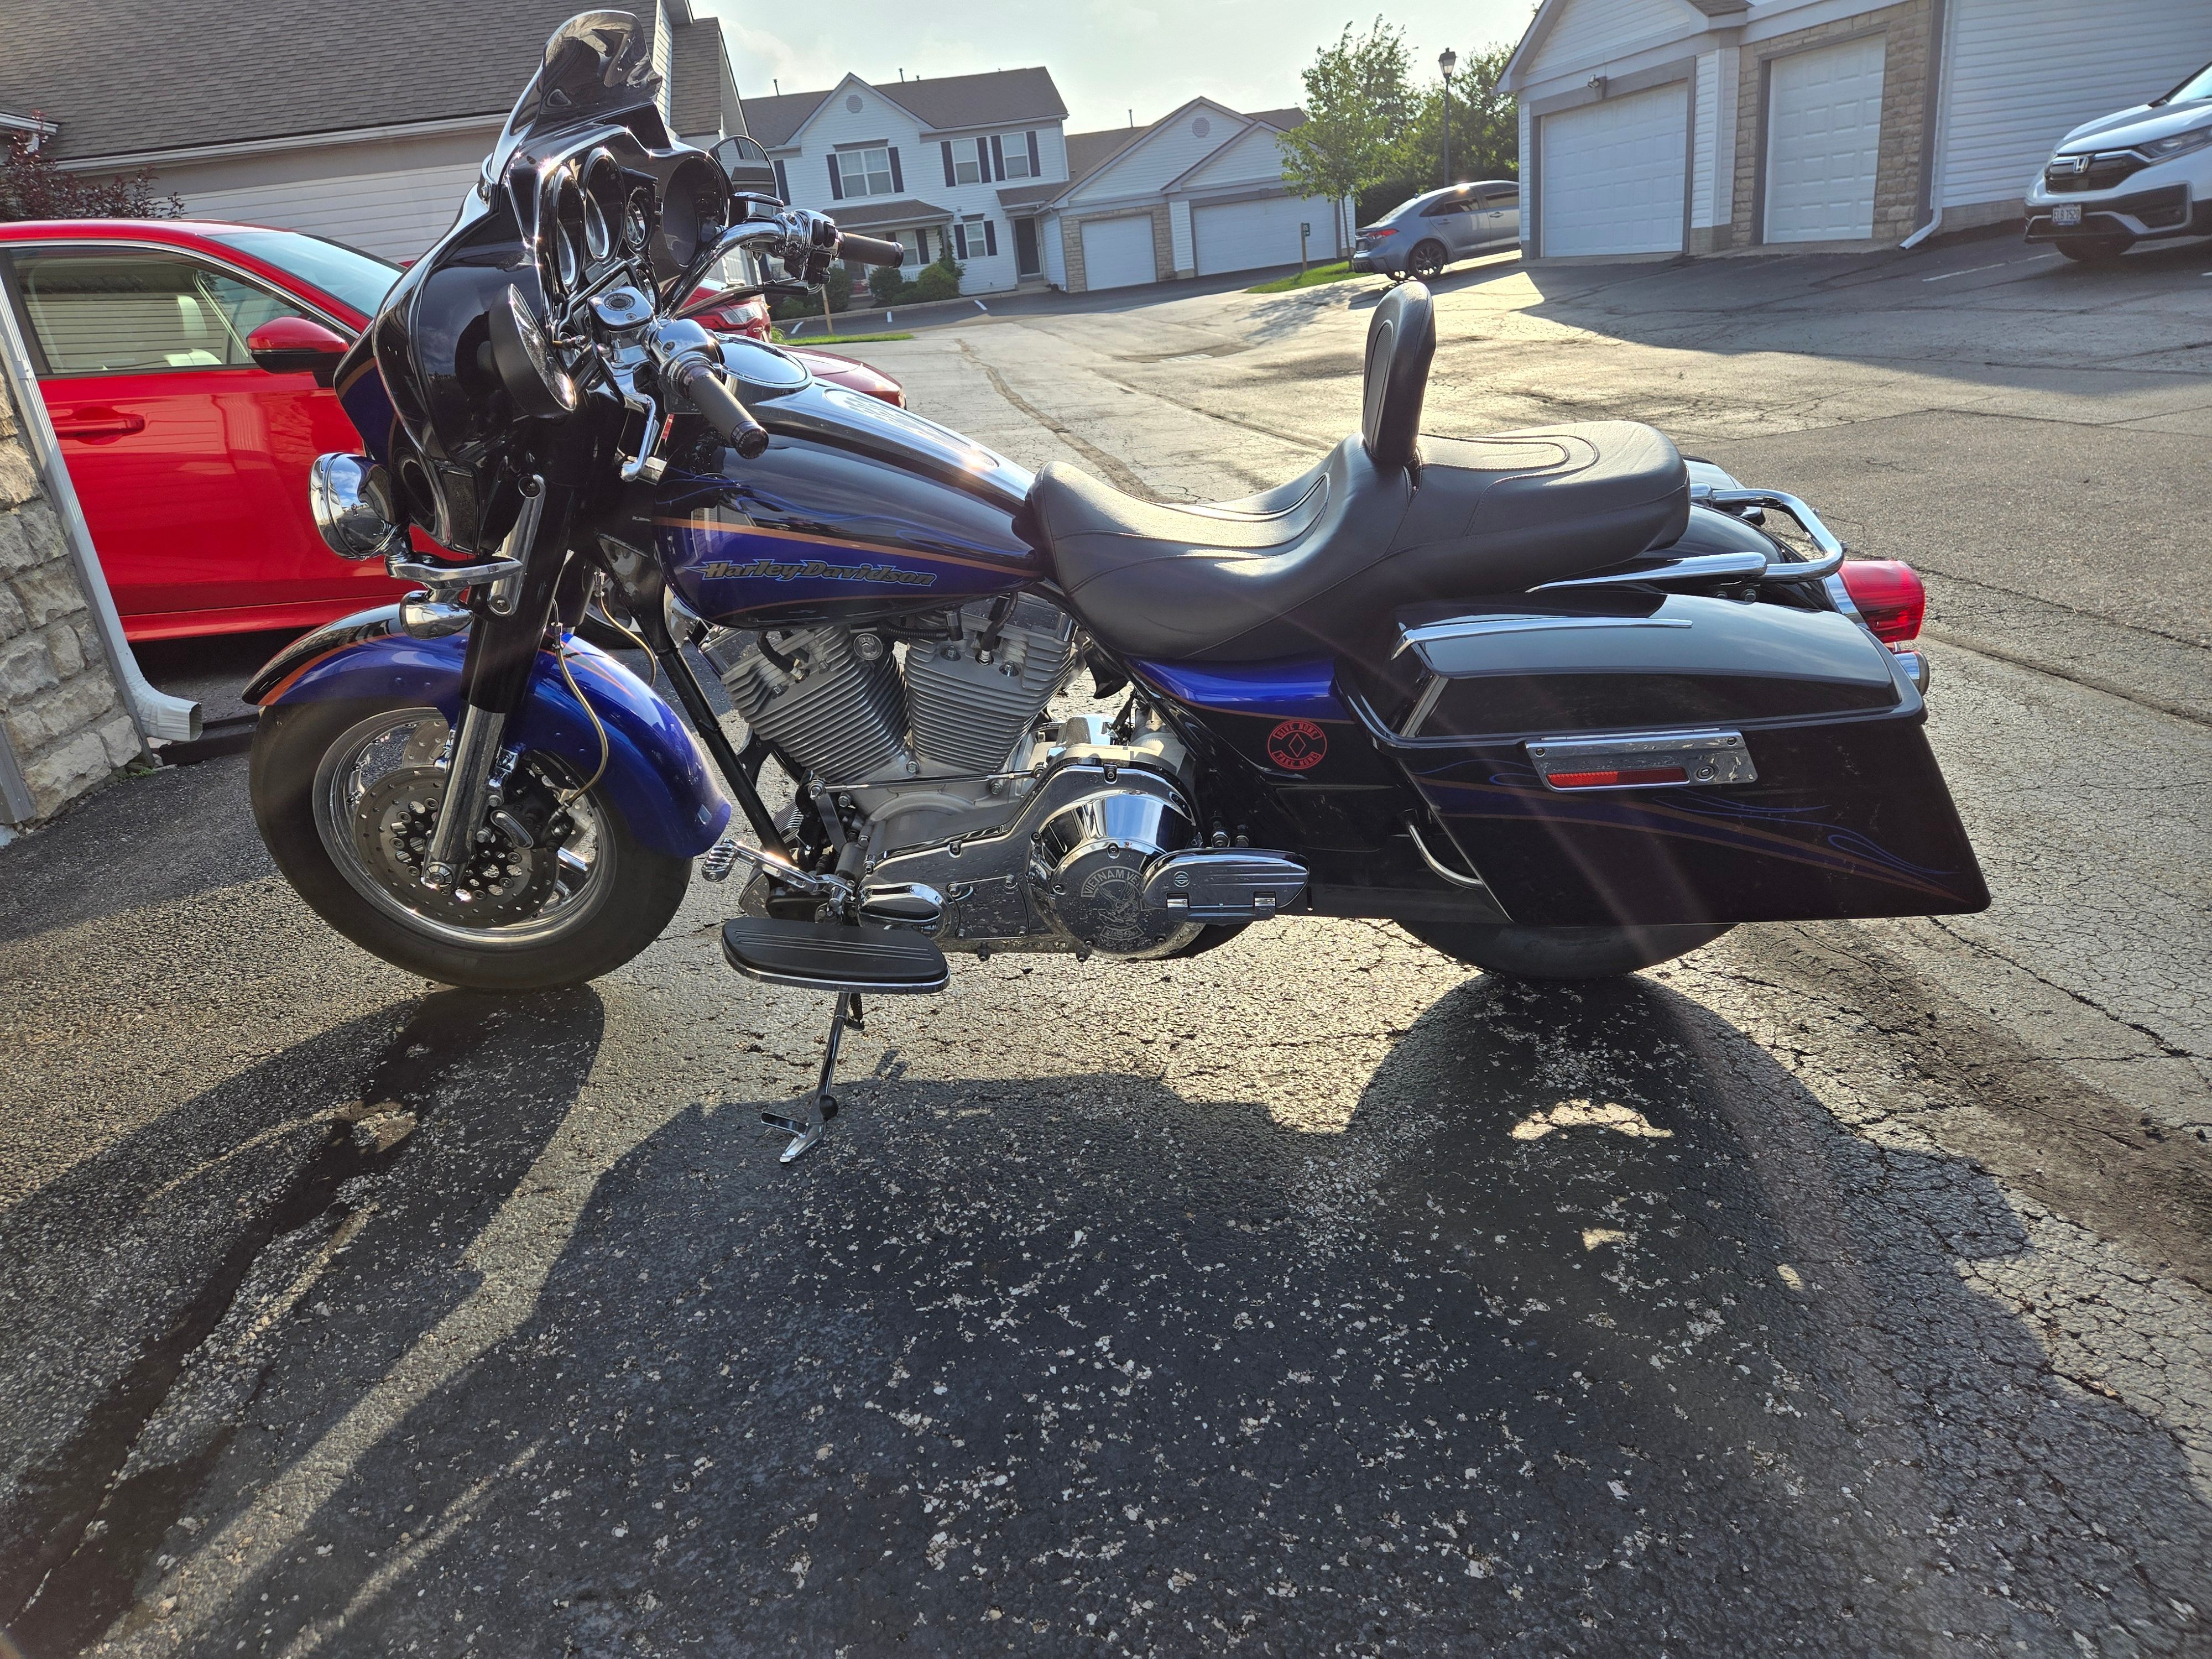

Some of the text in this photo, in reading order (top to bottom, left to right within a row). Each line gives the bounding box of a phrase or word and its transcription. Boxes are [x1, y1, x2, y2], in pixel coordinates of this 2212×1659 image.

[687, 559, 936, 587] Harley-Davidson
[1277, 723, 1317, 737] GIVE NONE
[1276, 753, 1318, 766] TAKE NONE
[1084, 869, 1124, 894] VIETNAM
